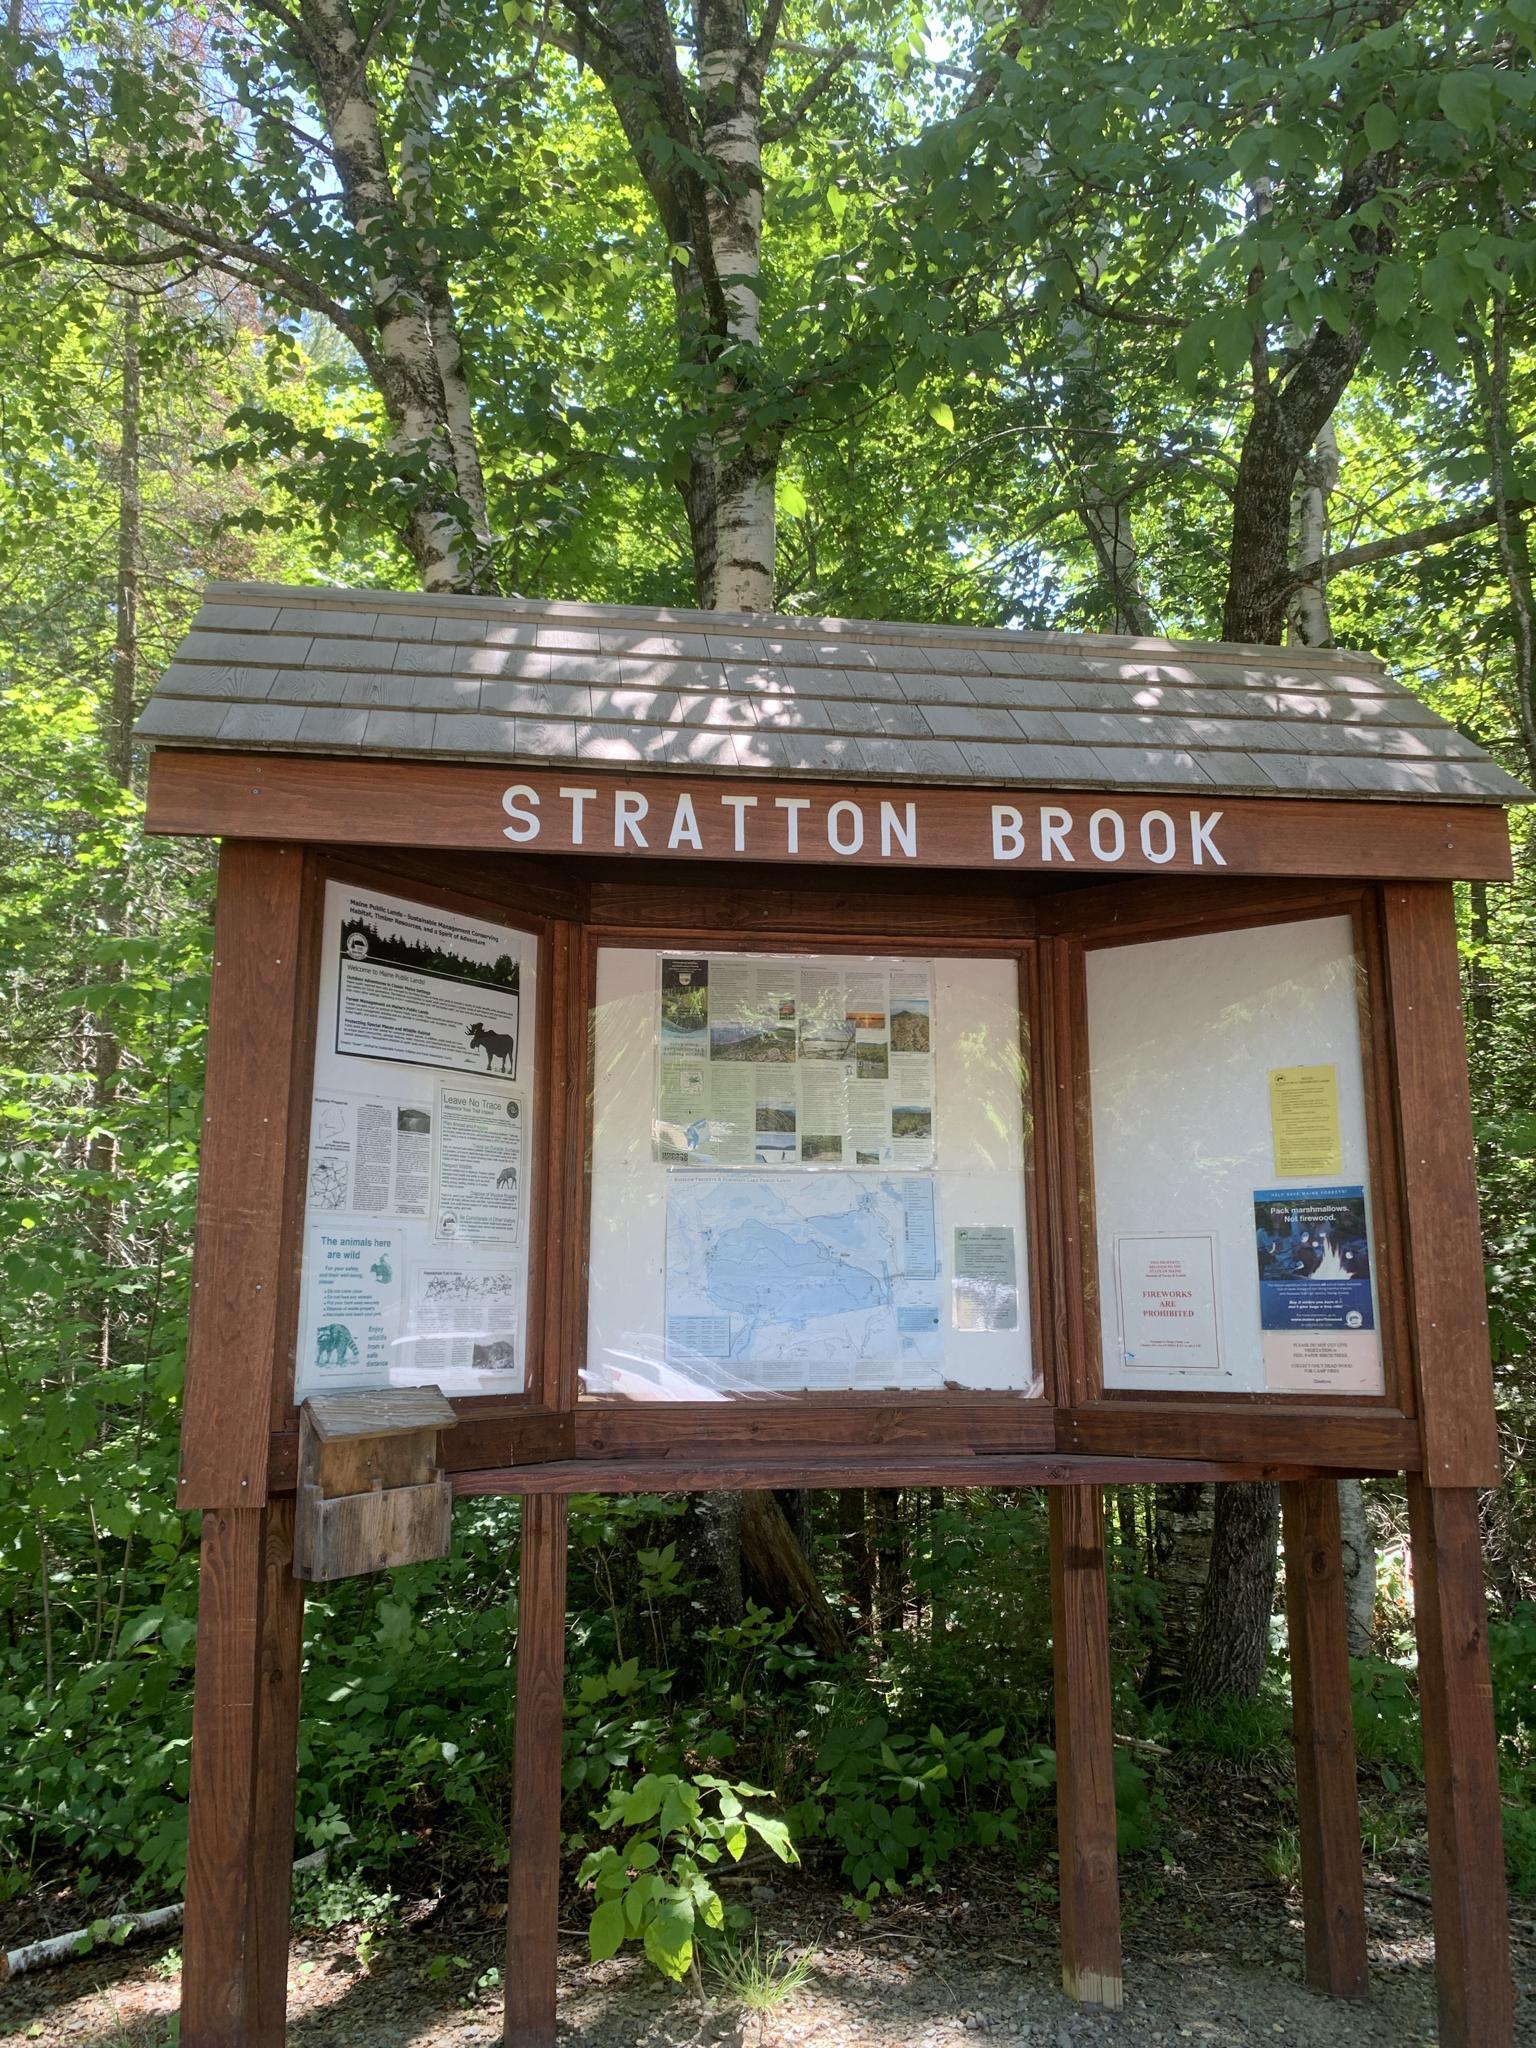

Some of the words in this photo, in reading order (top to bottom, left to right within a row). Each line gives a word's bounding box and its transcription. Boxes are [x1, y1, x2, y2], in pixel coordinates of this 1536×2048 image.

[502, 784, 918, 859] STRATTON
[992, 805, 1228, 867] BROOK
[350, 899, 368, 908] Maine
[370, 904, 386, 912] Public
[387, 908, 402, 917] Lands
[408, 913, 437, 926] Sustainable
[438, 920, 474, 934] Management
[472, 928, 499, 943] Conserving
[375, 912, 394, 923] Timber
[424, 925, 433, 934] and
[438, 929, 453, 940] Spirit
[460, 934, 486, 946] Adventure
[347, 964, 372, 975] Welcome
[373, 968, 378, 976] to
[379, 968, 394, 979] Maine
[395, 972, 410, 982] Public
[444, 1094, 466, 1106] Leave
[469, 1098, 480, 1108] No
[482, 1100, 502, 1111] Trace
[1270, 1207, 1290, 1215] Pack
[1291, 1206, 1350, 1214] marshmallows.
[1300, 1214, 1336, 1222] firewood.
[320, 1236, 338, 1246] The
[340, 1237, 372, 1247] animals
[374, 1238, 391, 1248] here
[344, 1250, 360, 1260] wild
[368, 1326, 384, 1334] Enjoy
